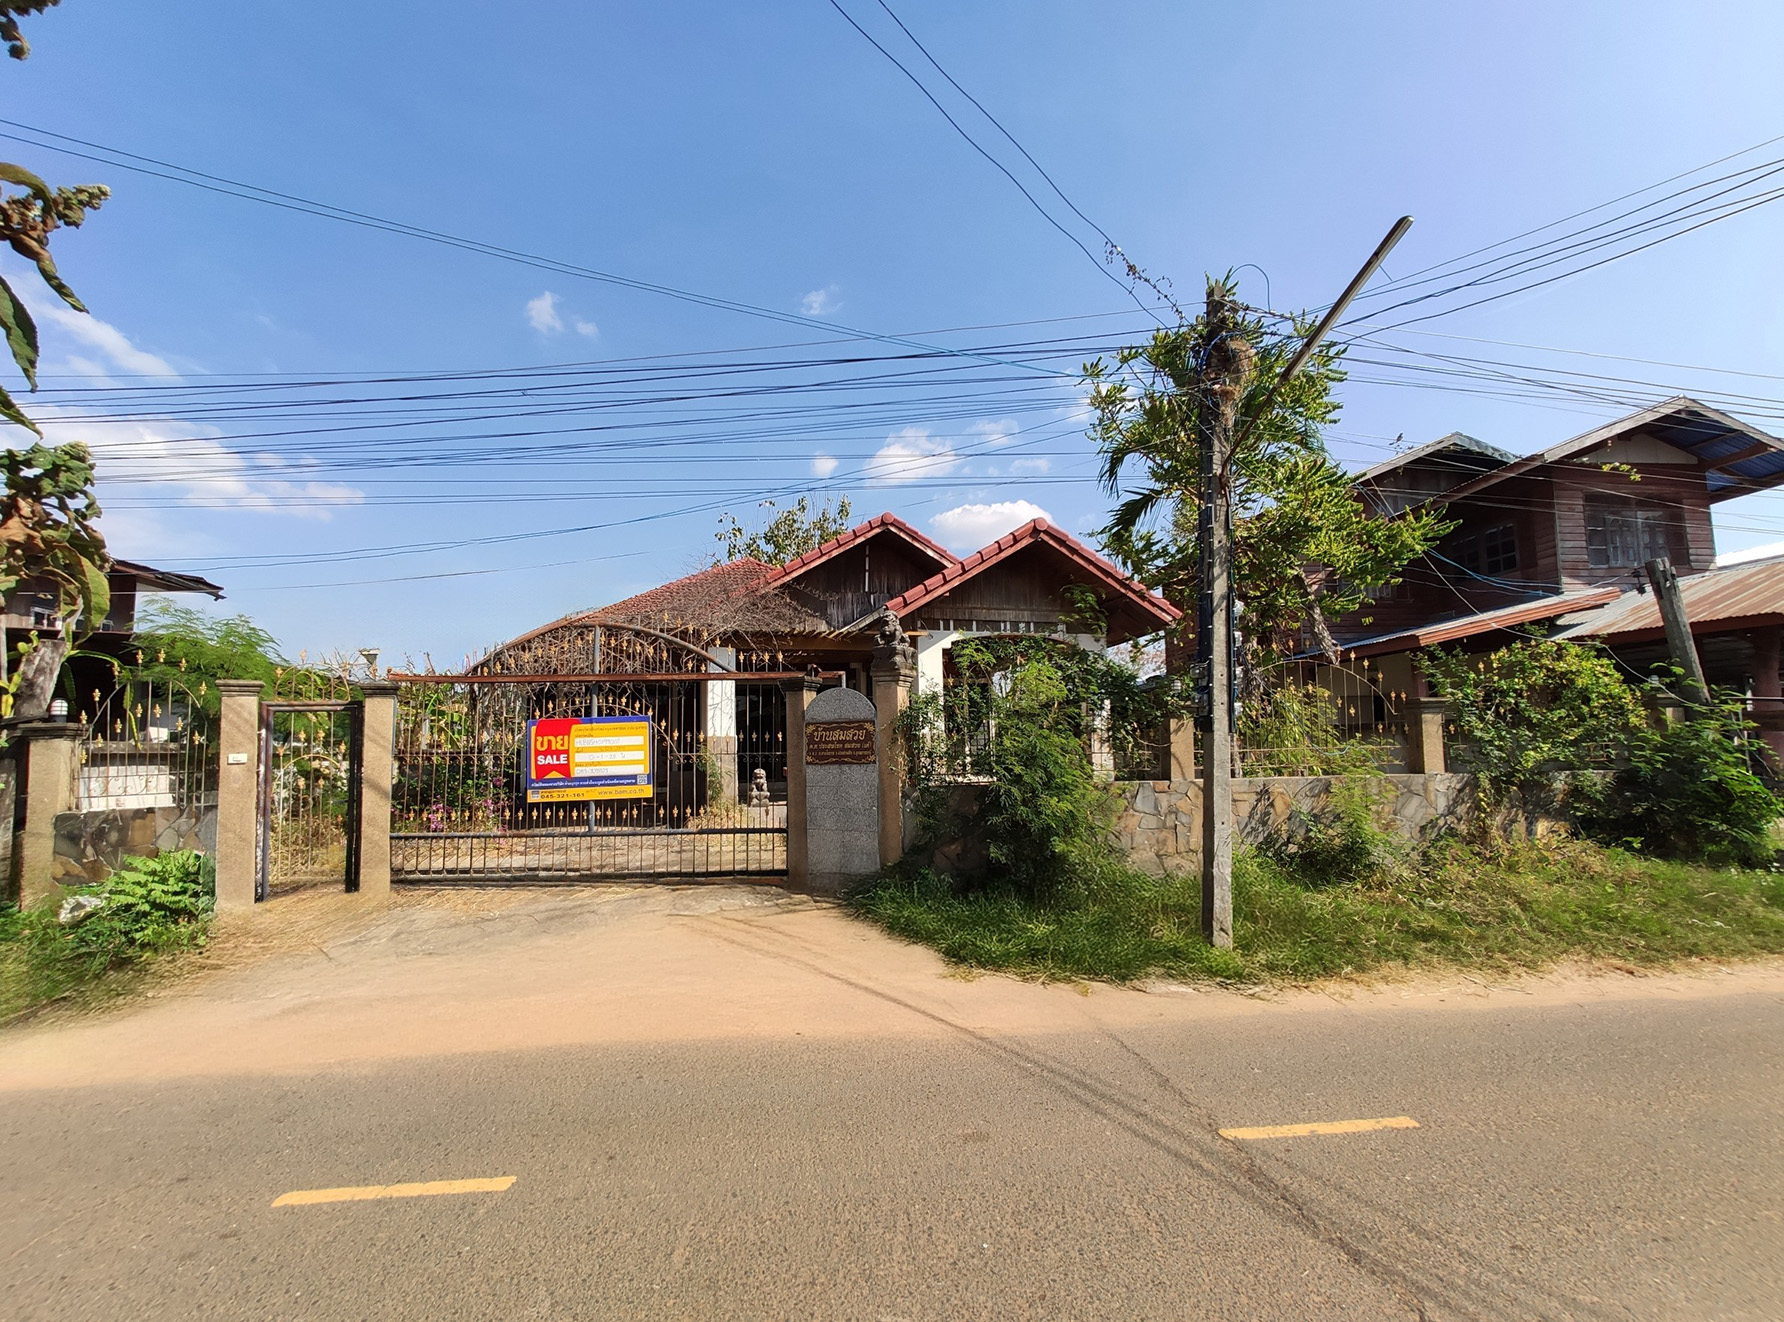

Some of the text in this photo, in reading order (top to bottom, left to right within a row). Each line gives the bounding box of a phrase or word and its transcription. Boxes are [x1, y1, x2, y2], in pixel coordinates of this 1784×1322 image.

[813, 727, 866, 741] บ้านสมสวย
[536, 735, 569, 751] ขาย
[537, 754, 568, 764] SALE
[598, 788, 645, 796] www.bam.co.th
